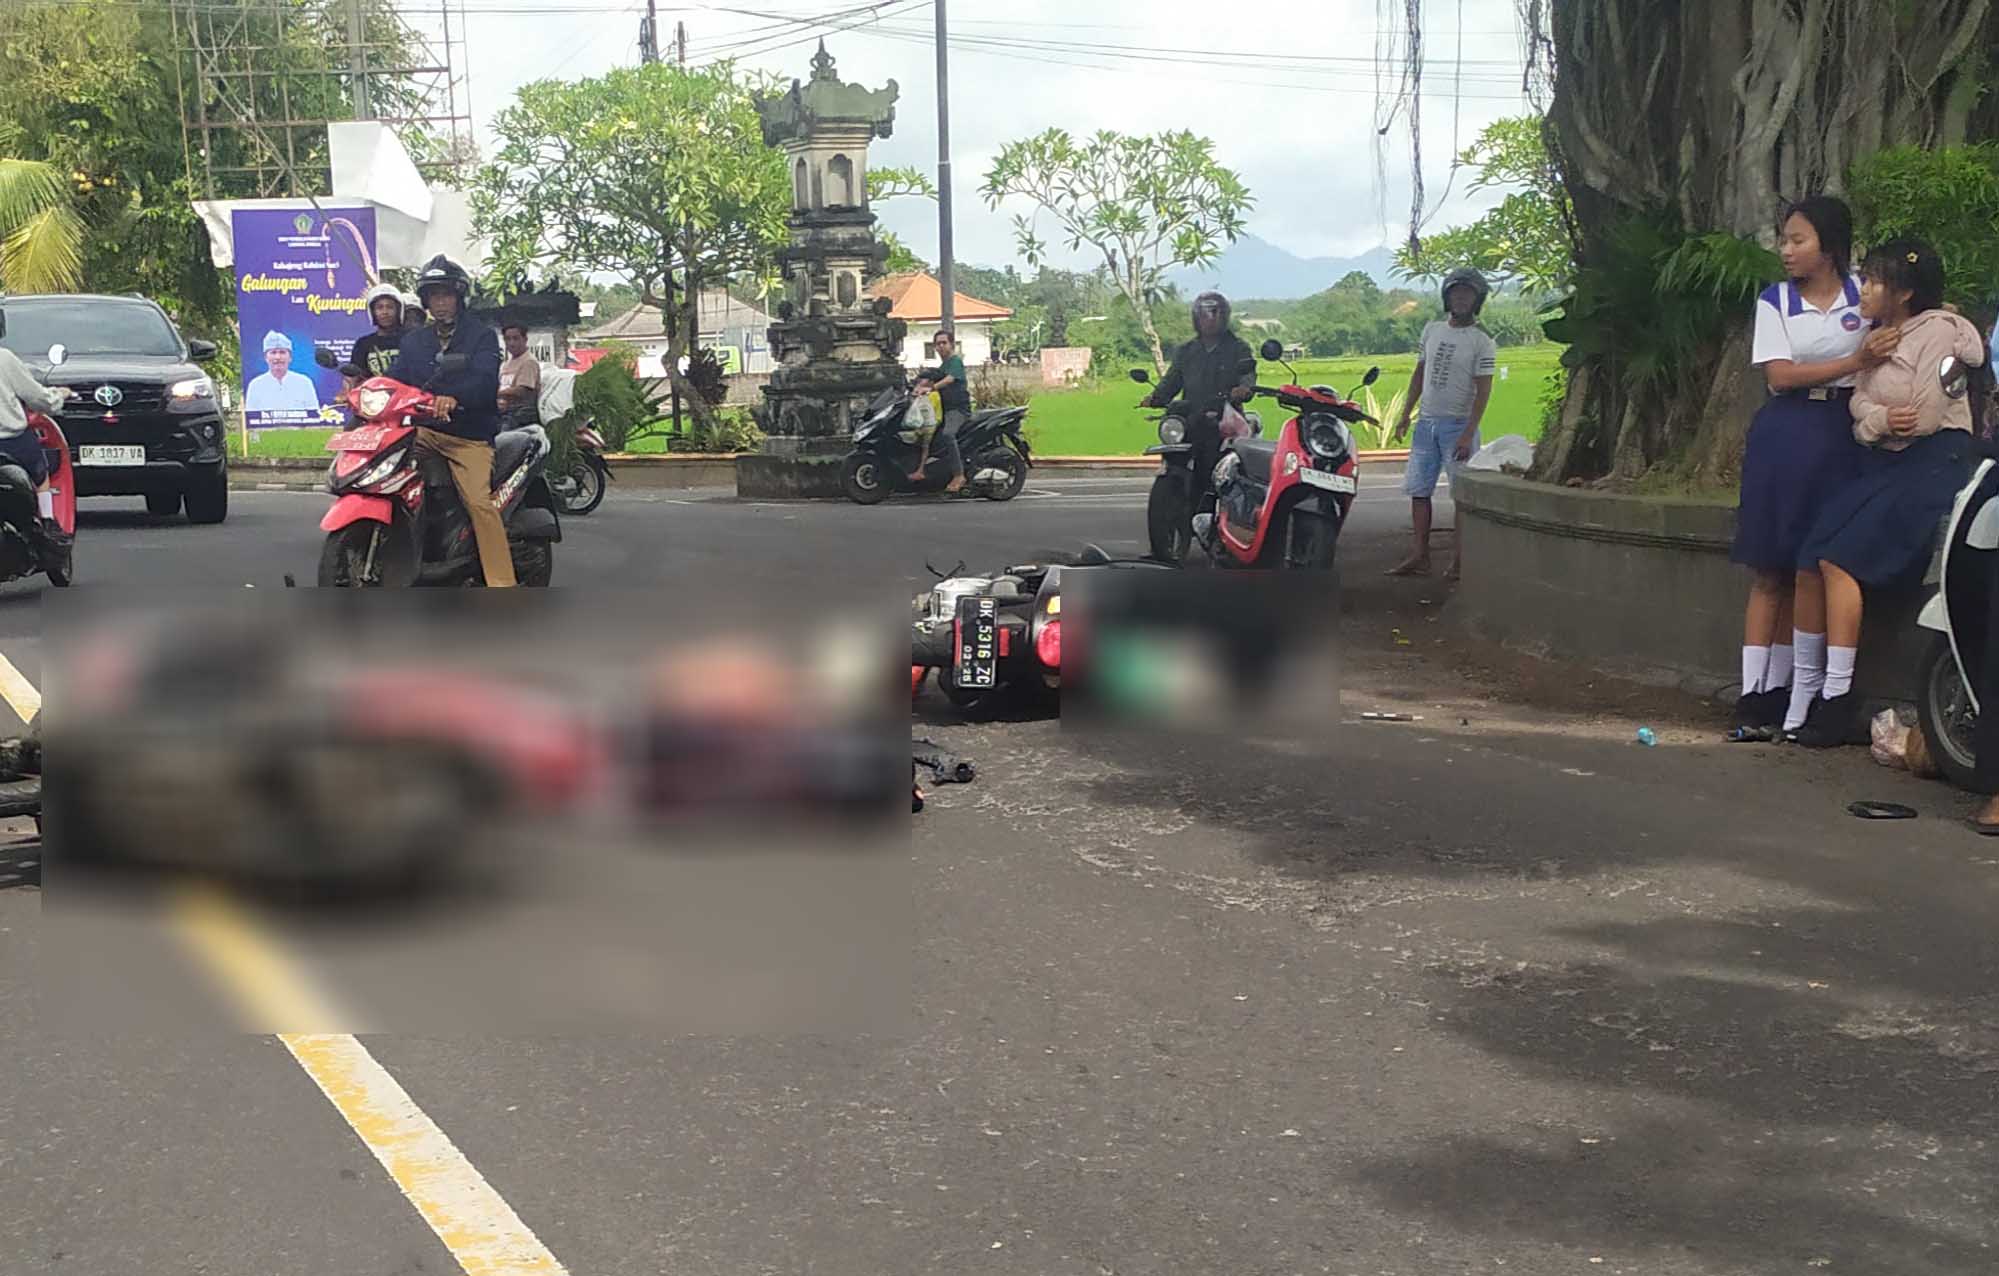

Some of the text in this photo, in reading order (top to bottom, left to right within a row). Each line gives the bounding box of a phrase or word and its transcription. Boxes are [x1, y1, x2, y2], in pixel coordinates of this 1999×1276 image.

[241, 272, 308, 295] Galungan
[81, 447, 96, 459] DK
[976, 600, 994, 685] DK 5316 ZC
